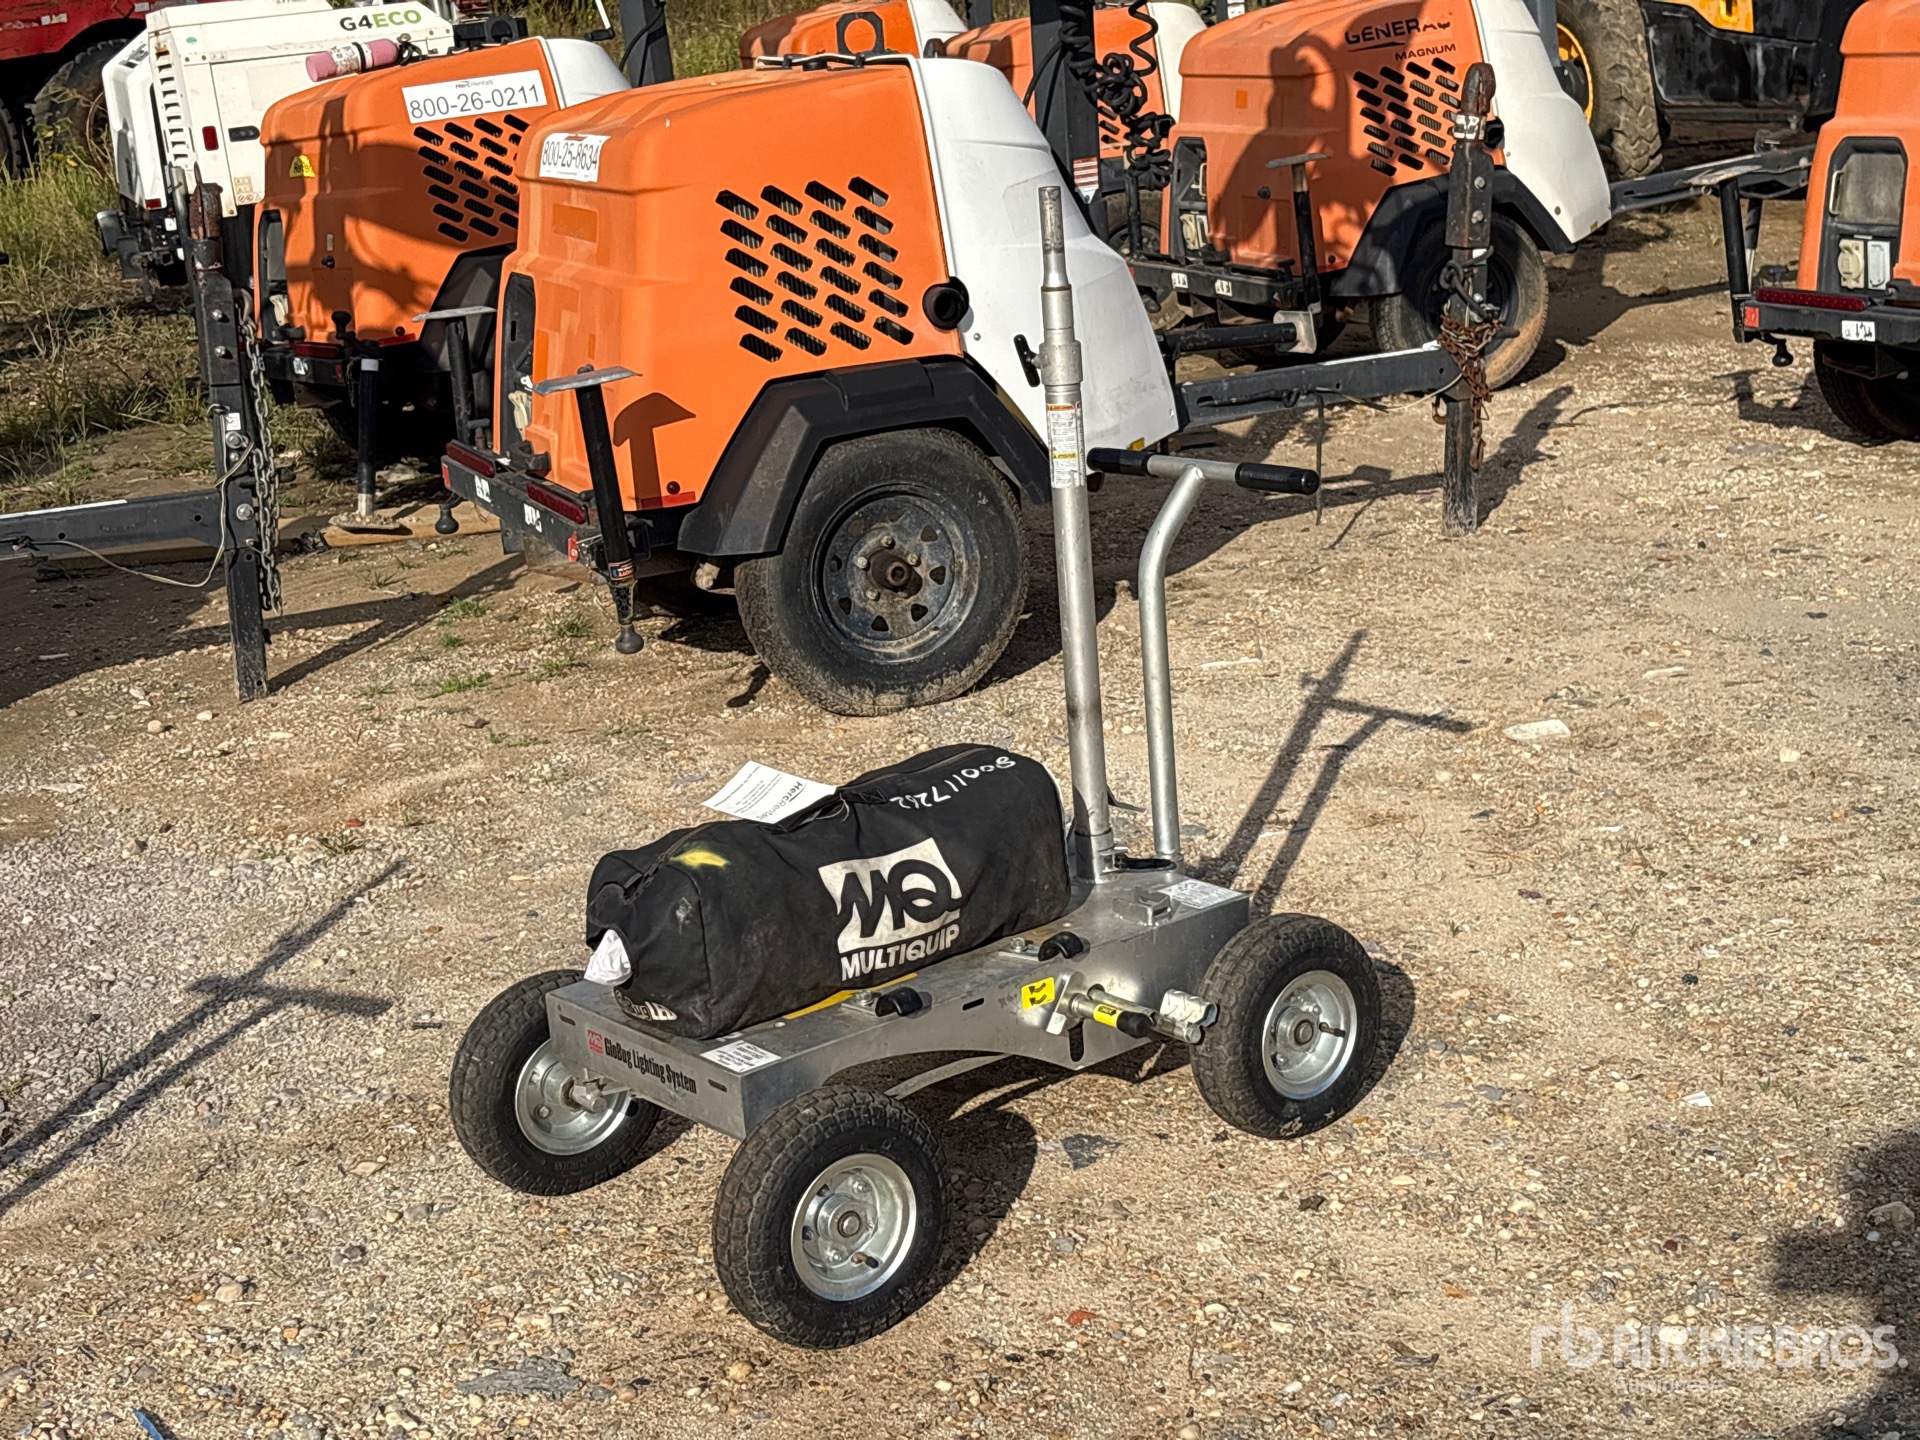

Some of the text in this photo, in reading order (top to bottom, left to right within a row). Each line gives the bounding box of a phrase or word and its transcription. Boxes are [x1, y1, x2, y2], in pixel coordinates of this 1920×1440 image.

[339, 9, 422, 31] G4ECO
[1394, 43, 1456, 61] MAGNUM
[409, 84, 540, 119] 800-26-0211
[542, 140, 600, 171] 800-25-8634
[840, 923, 961, 982] MULTIQUIP
[604, 1036, 633, 1069] GloBug
[632, 1048, 666, 1084] Lighting
[665, 1063, 697, 1095] System
